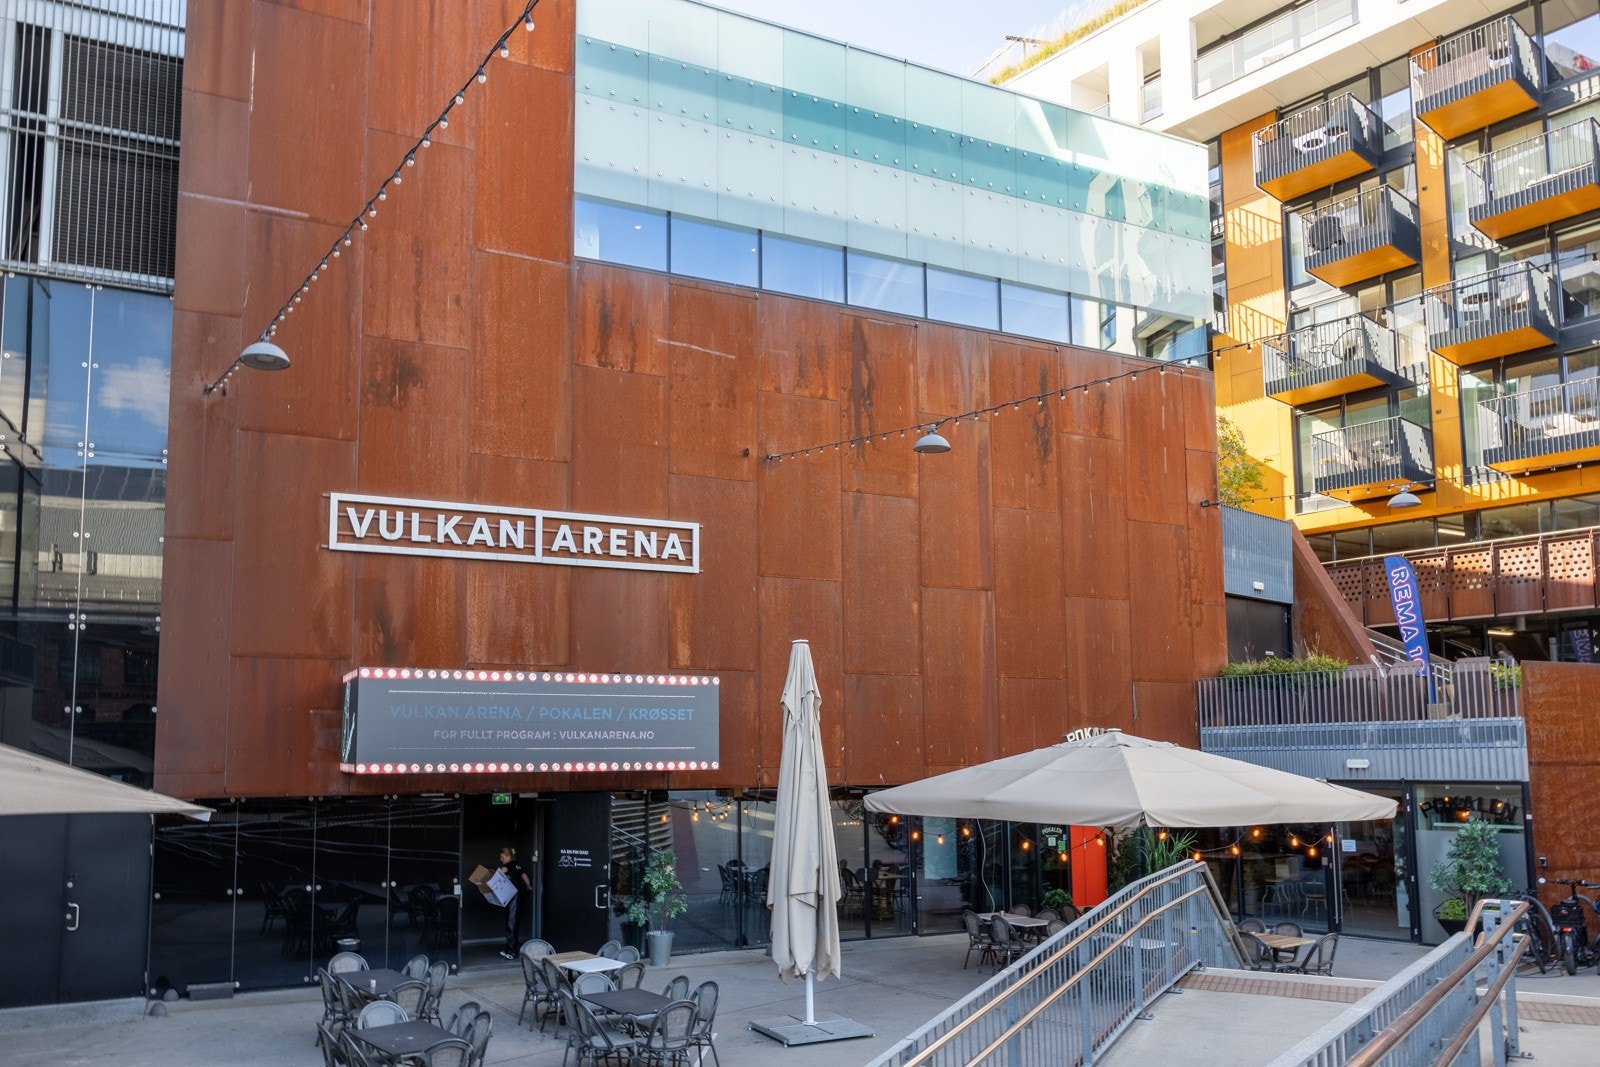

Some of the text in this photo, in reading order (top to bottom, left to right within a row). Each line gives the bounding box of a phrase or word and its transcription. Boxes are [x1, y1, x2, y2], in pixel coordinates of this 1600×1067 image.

[346, 507, 686, 561] VULKAN ARENA
[1391, 566, 1419, 643] REMA
[389, 704, 695, 722] VULKAN ARENA / POKALEN / KRØSSET
[433, 730, 457, 740] FOR
[460, 730, 494, 740] FULLT
[496, 730, 550, 740] PROGRAM
[559, 730, 655, 740] VULKANARENA.NO
